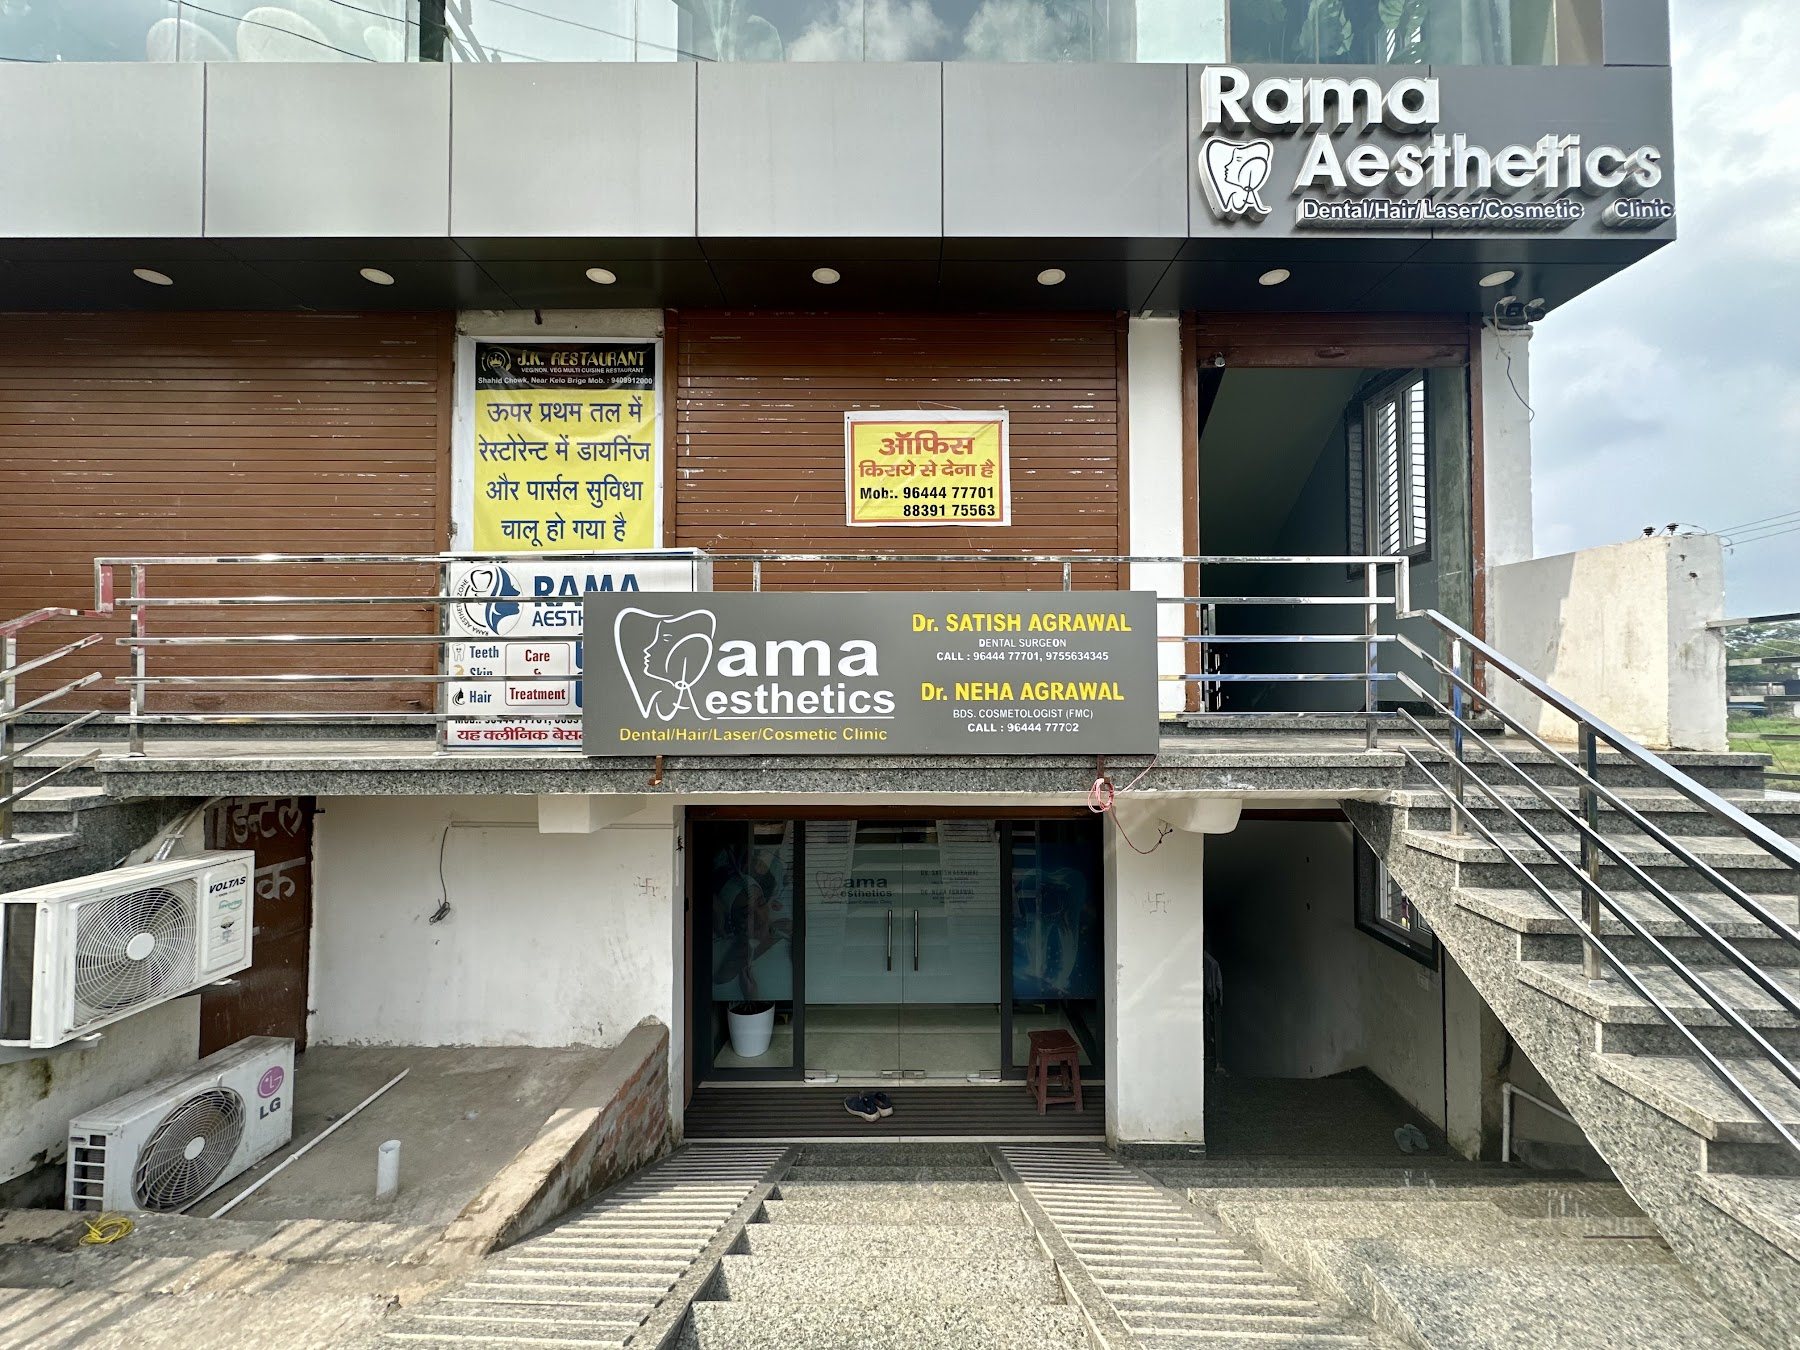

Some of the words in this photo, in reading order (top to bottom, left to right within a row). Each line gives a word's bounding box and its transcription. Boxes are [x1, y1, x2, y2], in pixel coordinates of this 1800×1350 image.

[1201, 65, 1440, 125] Rama
[1299, 132, 1662, 190] Aesthetics
[1302, 199, 1585, 221] Dental/Hair/Laser/Cosmetic
[1613, 197, 1675, 219] Clinic
[517, 350, 545, 366] J.K.
[551, 351, 647, 367] RESTAURANT
[477, 376, 503, 384] Shahid
[530, 376, 548, 384] Near
[487, 402, 533, 423] ऊपर
[539, 402, 583, 423] प्रथम
[590, 402, 622, 423] तल
[628, 395, 643, 423] में
[478, 433, 548, 462] रेस्टोरेन्ट
[555, 433, 570, 462] में
[878, 429, 976, 456] ऑफिस
[858, 459, 917, 478] किराये
[919, 460, 938, 478] से
[941, 459, 977, 477] देना
[980, 458, 996, 478] है
[486, 472, 520, 501] और
[527, 473, 579, 501] पार्सल
[586, 473, 644, 508] सुविधा
[902, 486, 947, 499] 96444
[951, 486, 994, 499] 77701
[902, 504, 946, 517] 88391
[951, 504, 996, 517] 75563
[501, 519, 544, 547] चालू
[546, 511, 566, 542] हो
[573, 519, 607, 540] गया
[612, 511, 627, 543] है
[912, 613, 939, 633] Dr.
[946, 613, 1021, 633] SATISH
[1028, 613, 1132, 633] AGRAWAL
[978, 638, 1017, 648] DENTAL
[1018, 638, 1067, 648] SURGEON
[469, 645, 500, 659] Teeth
[525, 649, 551, 662] Care
[936, 652, 964, 661] CALL
[973, 652, 1005, 661] 96444
[1008, 652, 1043, 662] 77701,
[1045, 652, 1109, 661] 9755634345
[469, 690, 492, 703] Hair
[509, 687, 566, 700] Treatment
[921, 682, 948, 701] Dr.
[955, 682, 1014, 701] NEHA
[1020, 682, 1125, 701] AGRAWAL
[953, 709, 976, 719] BDS.
[978, 709, 1063, 719] COSMETOLOGIST
[1065, 709, 1094, 719] (FMC)
[457, 730, 482, 740] यह
[619, 727, 837, 742] Dental/Hair/Laser/Cosmetic
[842, 727, 888, 741] Clinic
[967, 723, 997, 733] CALL
[1007, 723, 1042, 733] 96444
[1045, 723, 1079, 733] 77702
[209, 876, 247, 894] VOLTAS
[259, 1097, 281, 1120] LG
